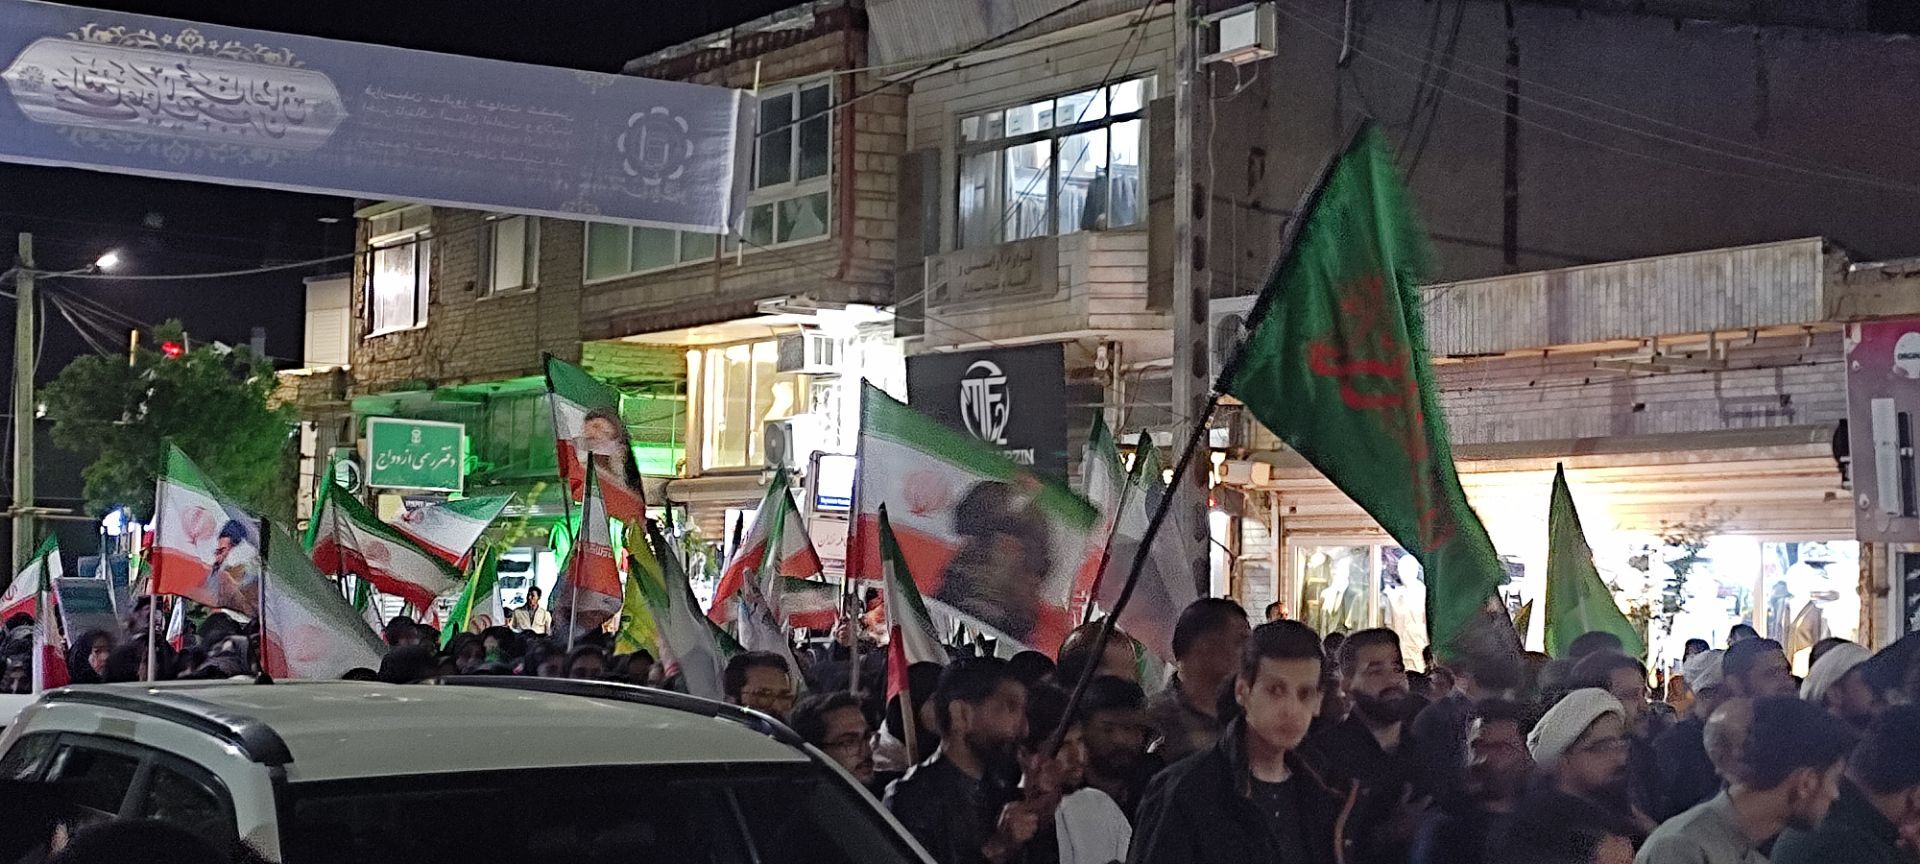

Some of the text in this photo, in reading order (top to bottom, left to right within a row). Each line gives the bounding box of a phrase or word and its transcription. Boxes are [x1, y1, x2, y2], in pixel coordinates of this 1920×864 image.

[375, 445, 457, 471] دفتر رسمی ازدواج
